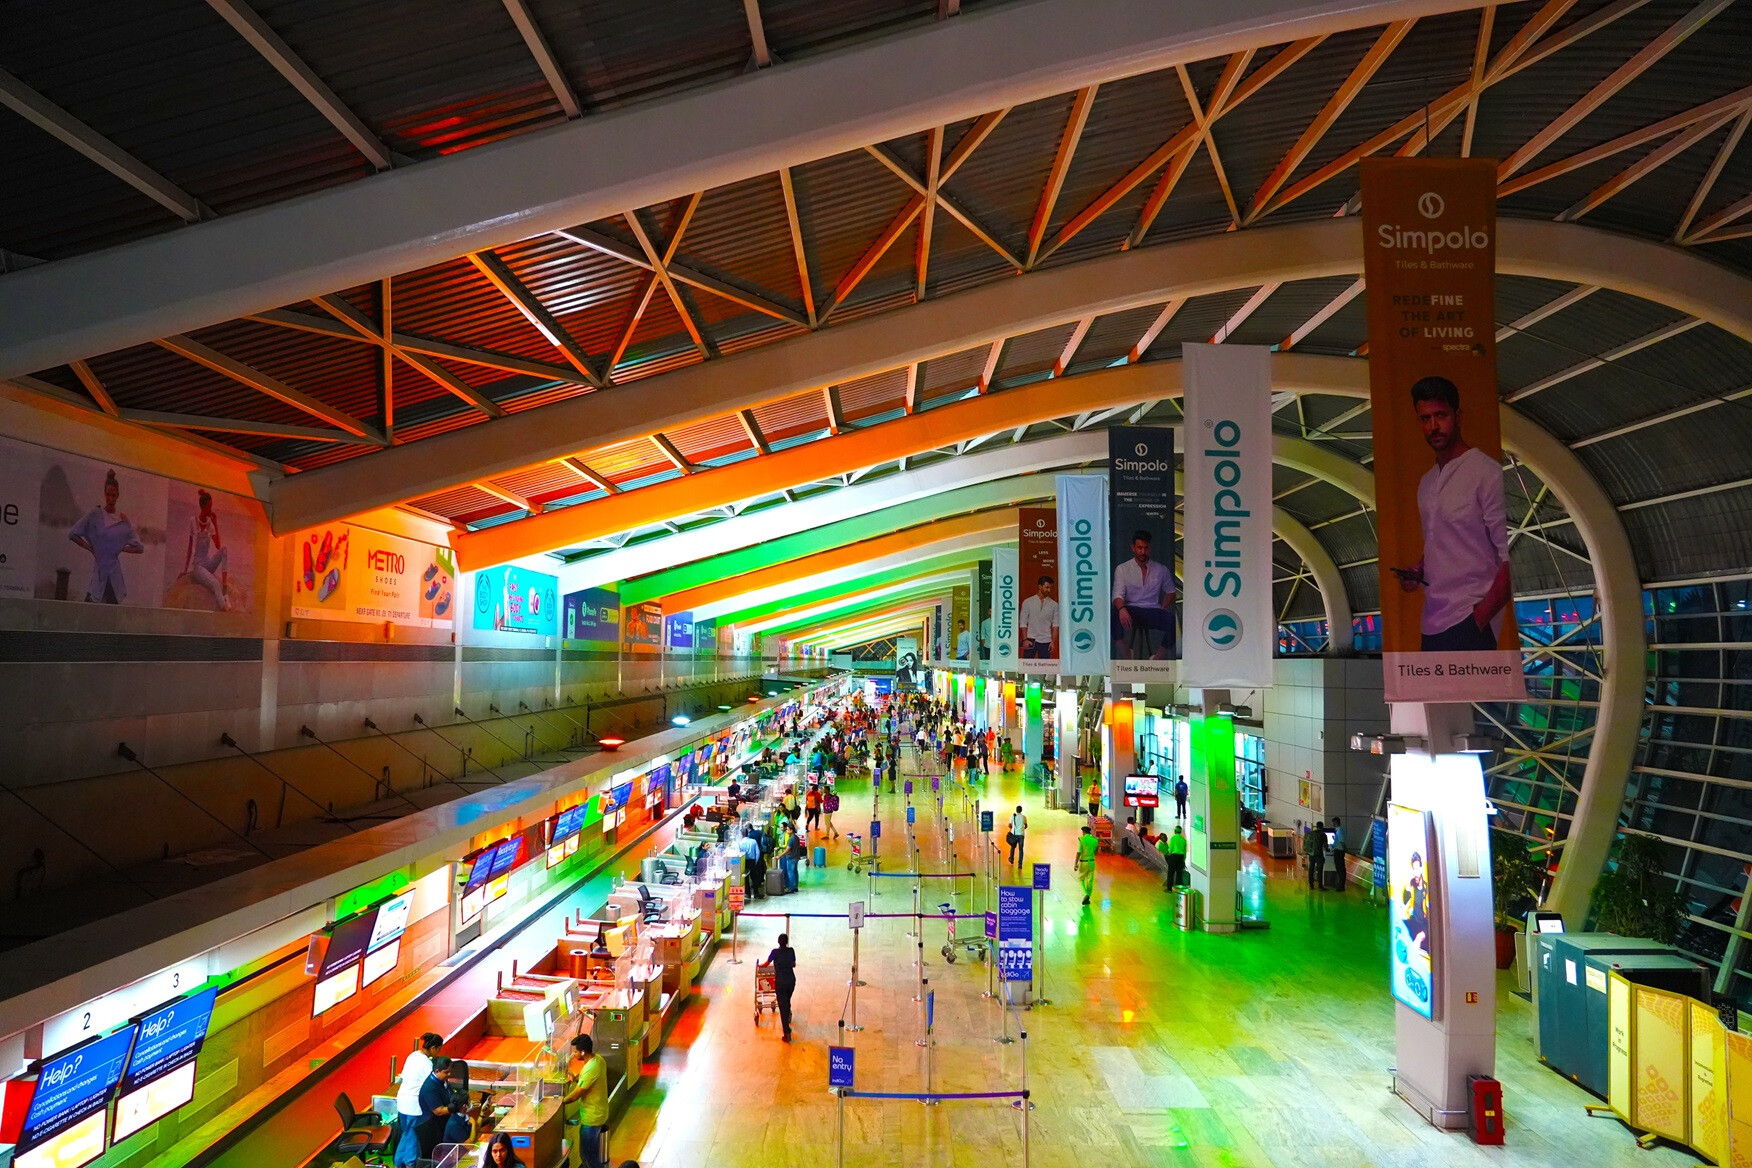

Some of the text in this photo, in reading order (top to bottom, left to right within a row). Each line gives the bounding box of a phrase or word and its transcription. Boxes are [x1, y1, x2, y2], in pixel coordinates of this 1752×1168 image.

[1378, 224, 1488, 254] Simpolo
[1396, 261, 1474, 270] Tiles & Bathware
[1393, 295, 1463, 306] REDEFINE
[1401, 311, 1464, 322] THE ART
[1400, 327, 1474, 338] OF LIVING
[1115, 458, 1168, 474] Simpolo
[1204, 420, 1250, 598] Simpolo
[1023, 529, 1058, 539] Simpolo
[368, 549, 404, 574] METRO
[1070, 519, 1098, 622] Simpolo
[998, 574, 1016, 639] Simpolo
[1398, 664, 1512, 676] Tiles & Bathware
[173, 973, 179, 988] 3
[83, 1012, 90, 1030] 2
[140, 1010, 174, 1040] Help?
[40, 1055, 83, 1090] Help?
[832, 1064, 851, 1072] entry
